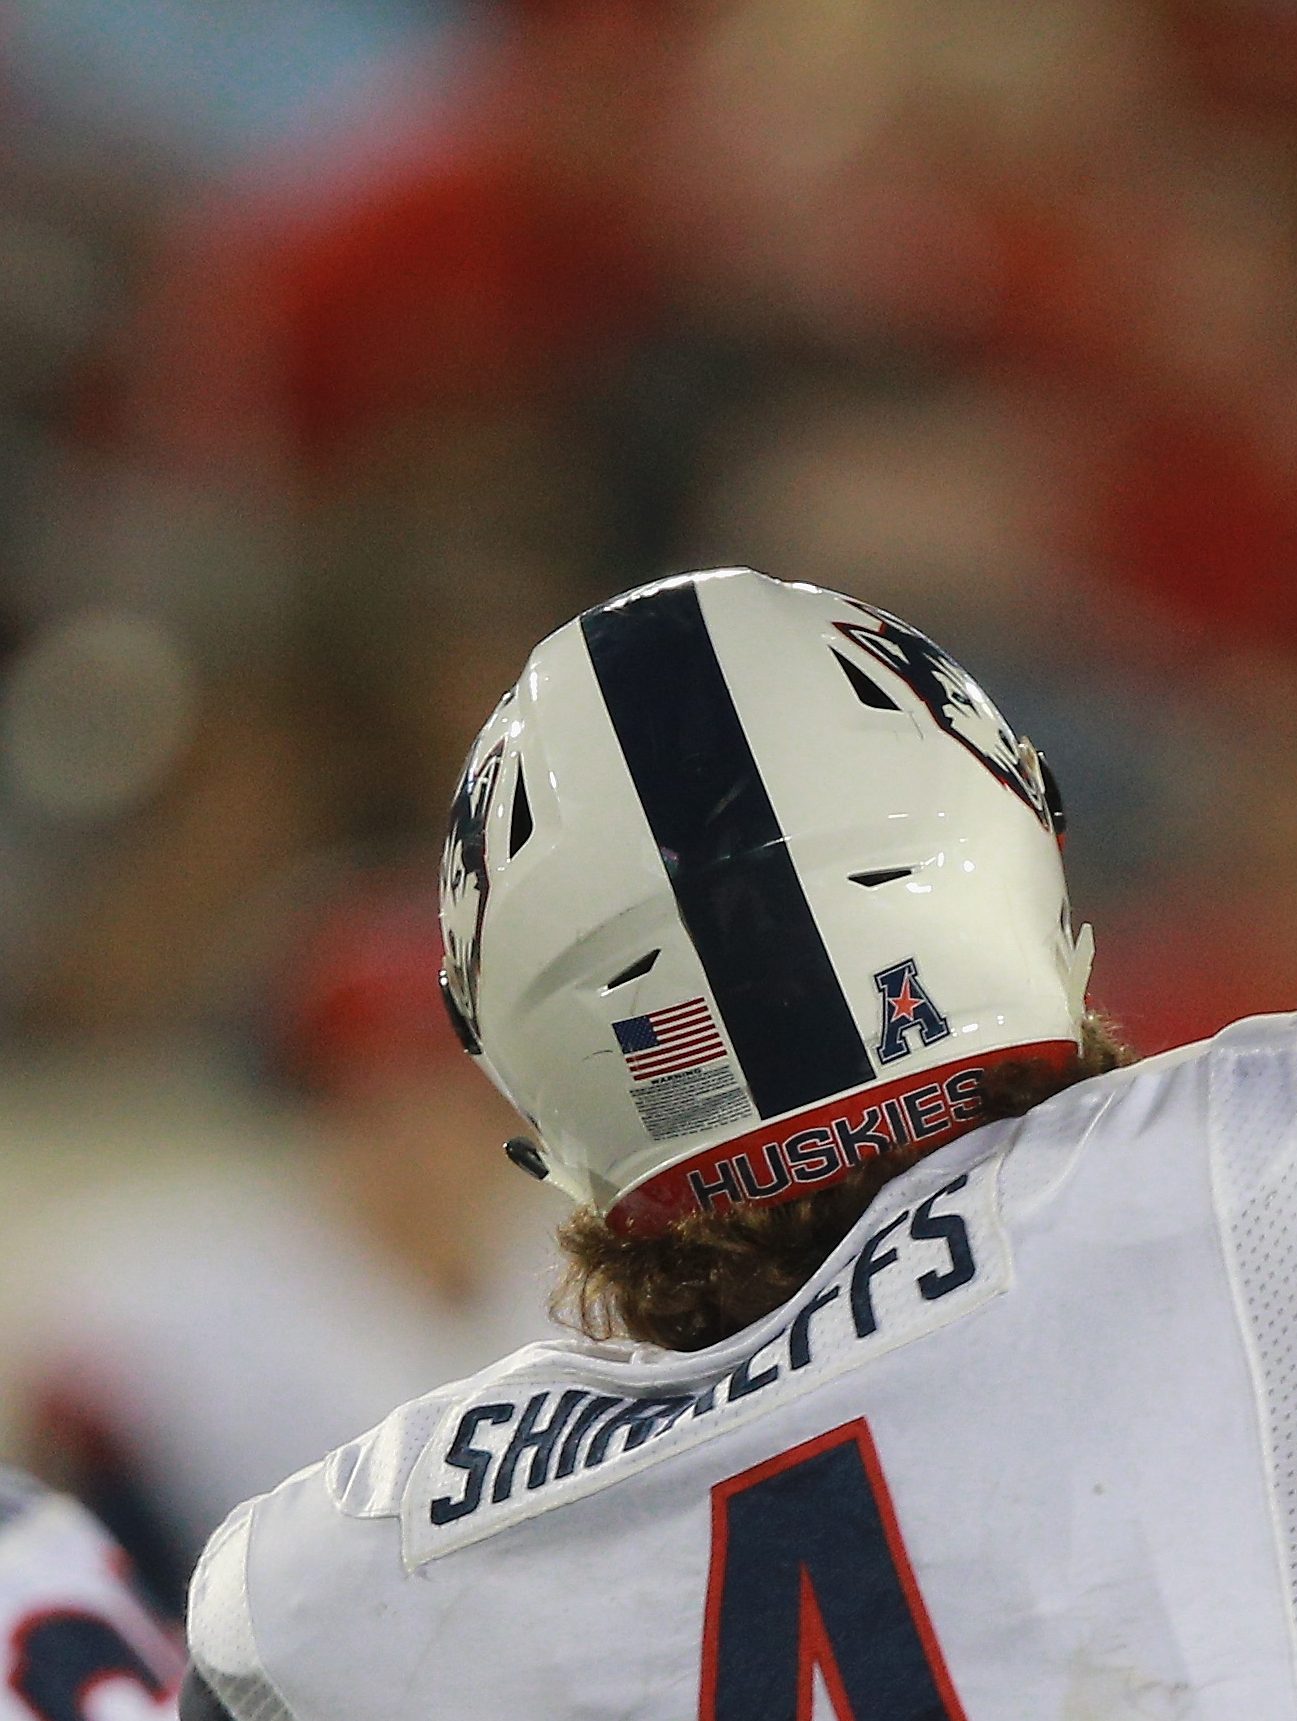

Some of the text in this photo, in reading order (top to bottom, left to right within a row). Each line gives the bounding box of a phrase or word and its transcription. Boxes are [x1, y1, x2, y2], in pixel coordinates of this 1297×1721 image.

[651, 1067, 702, 1085] WARNING
[687, 1067, 986, 1213] HUSKIES
[430, 1174, 977, 1526] SHIRFFS
